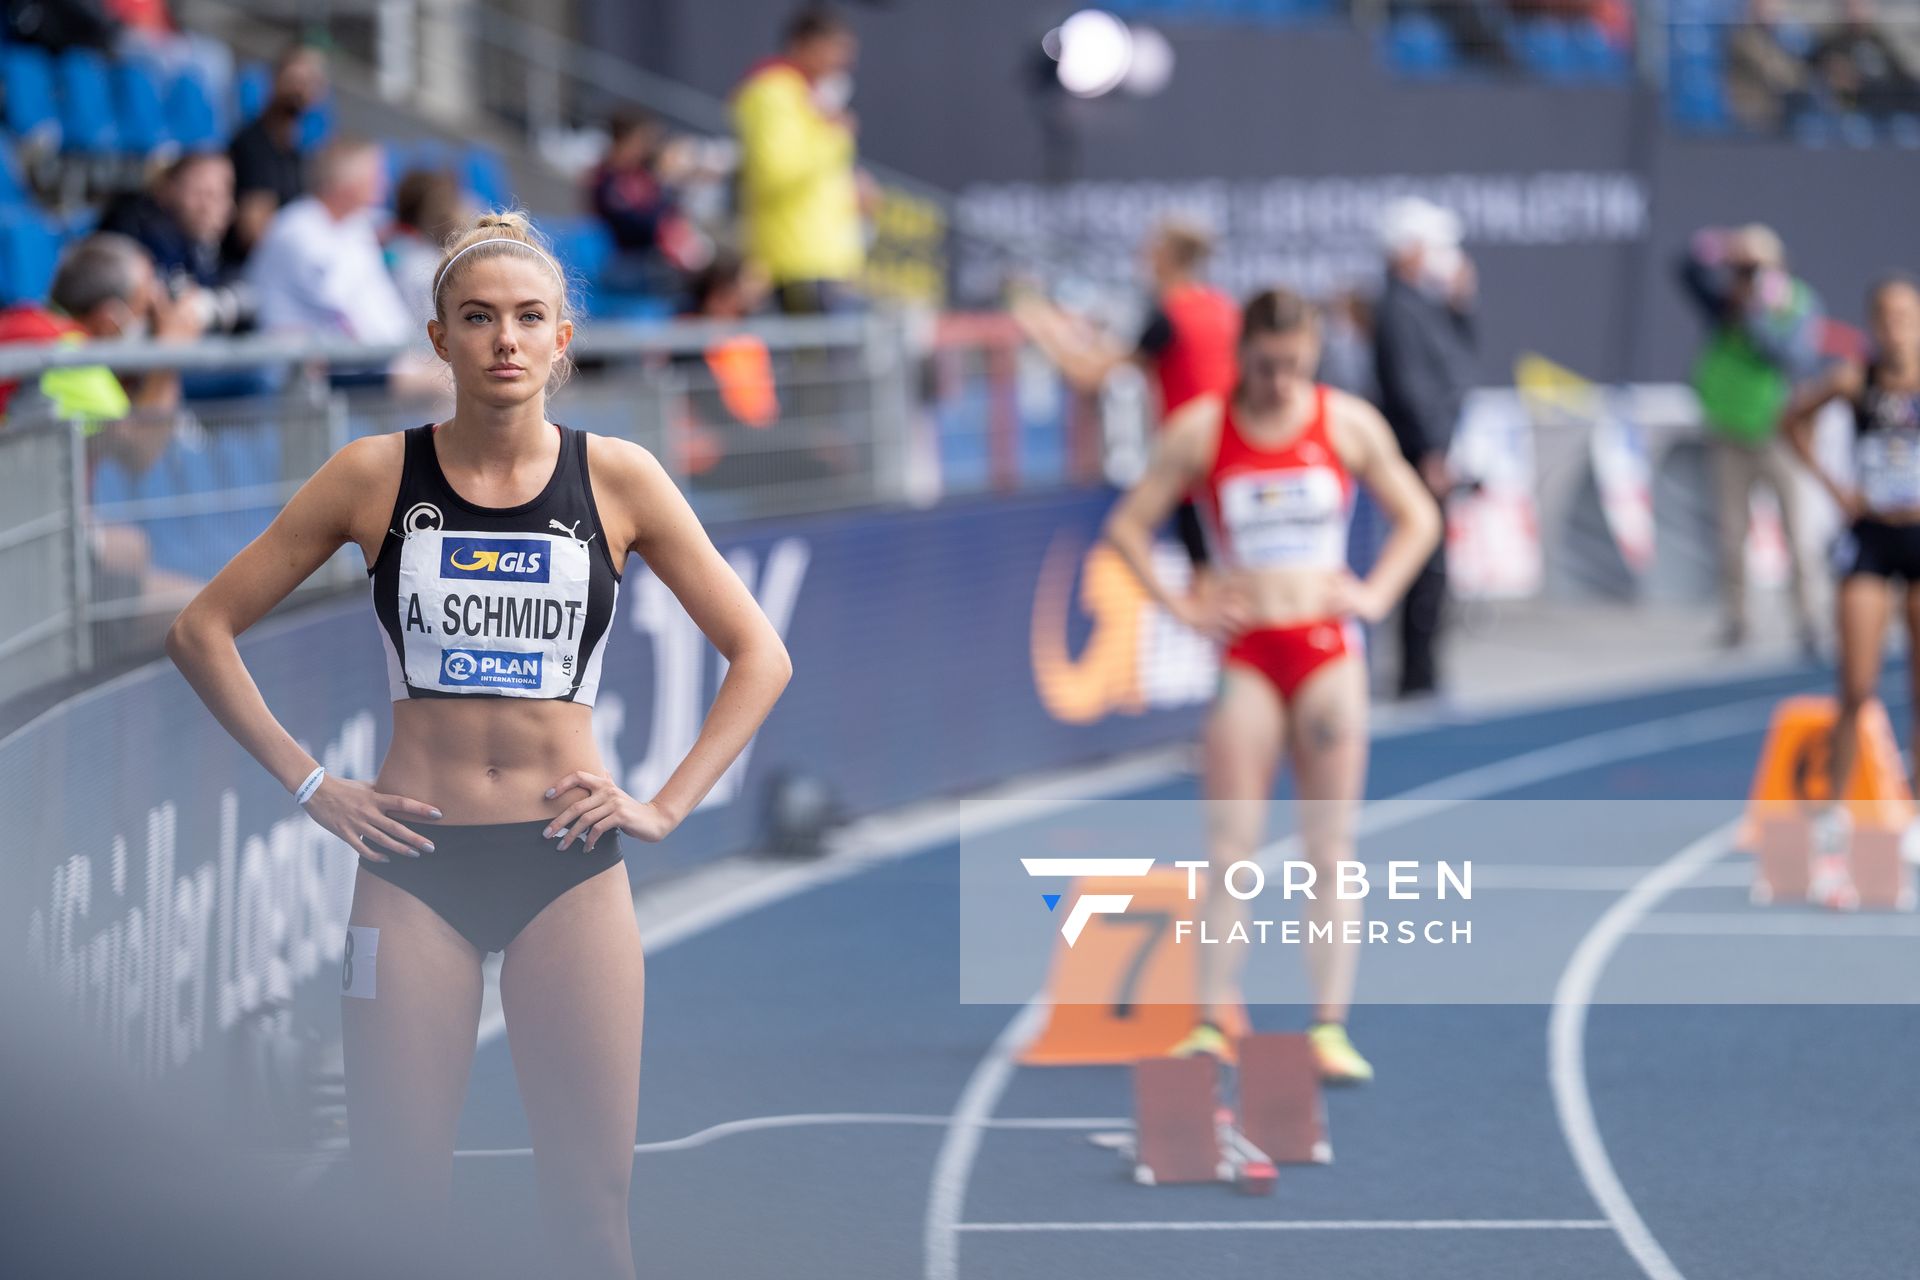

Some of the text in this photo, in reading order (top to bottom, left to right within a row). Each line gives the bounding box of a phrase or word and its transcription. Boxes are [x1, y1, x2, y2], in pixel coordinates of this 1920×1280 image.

[498, 552, 542, 574] GLS
[406, 592, 582, 641] A. SCHMIDT
[481, 657, 538, 676] PLAN
[562, 654, 574, 677] 307
[480, 675, 537, 685] INTERNATIONAL
[1100, 909, 1174, 1020] 7
